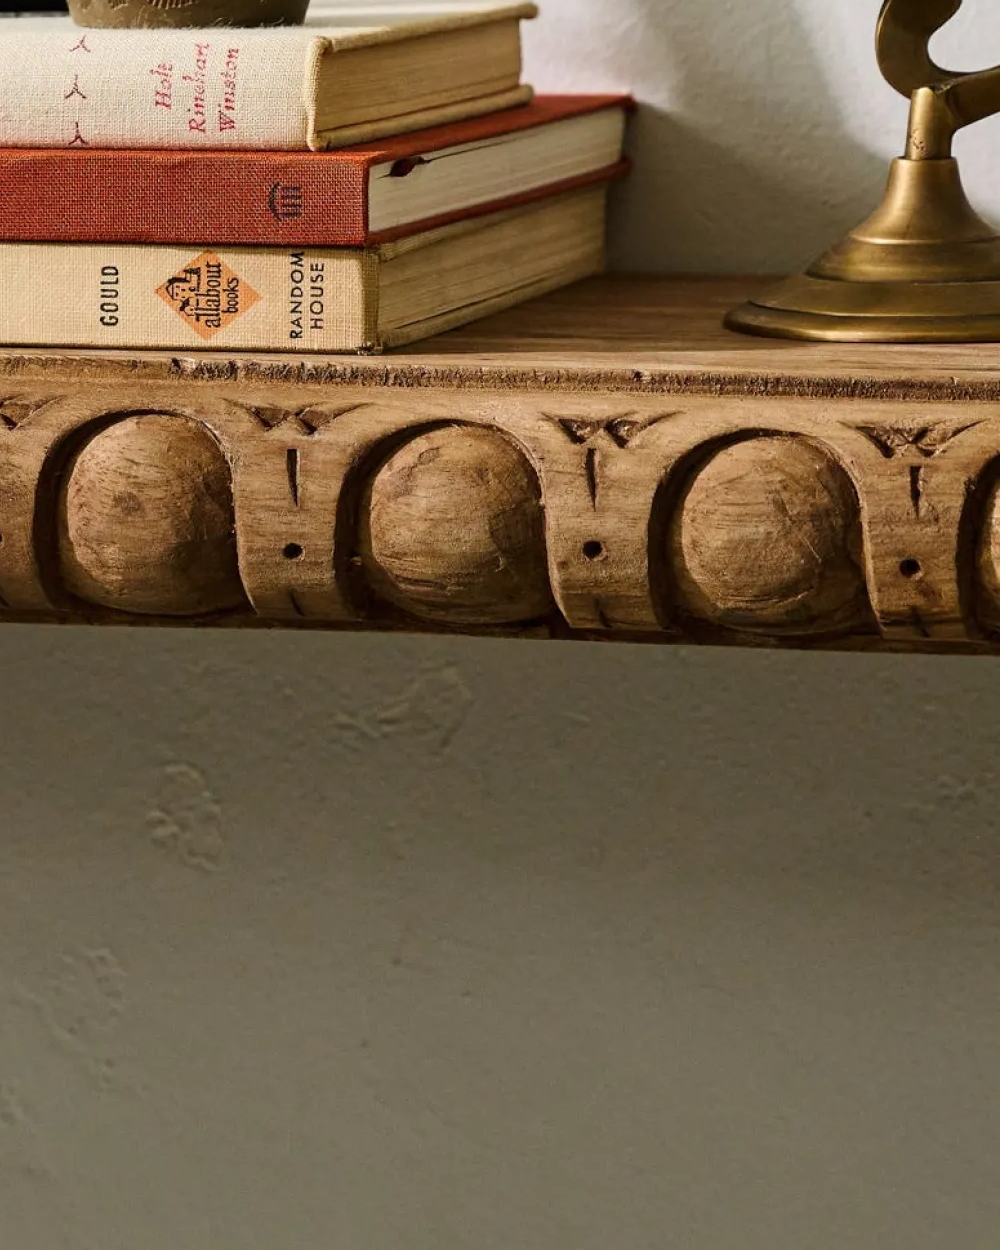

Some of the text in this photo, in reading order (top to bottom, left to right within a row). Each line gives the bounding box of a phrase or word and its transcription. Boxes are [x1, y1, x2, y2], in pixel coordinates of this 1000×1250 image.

[217, 47, 240, 133] Winston
[100, 265, 119, 327] GOULD
[220, 277, 239, 314] books
[289, 251, 304, 339] RANDOM
[309, 262, 325, 330] HOUSE
